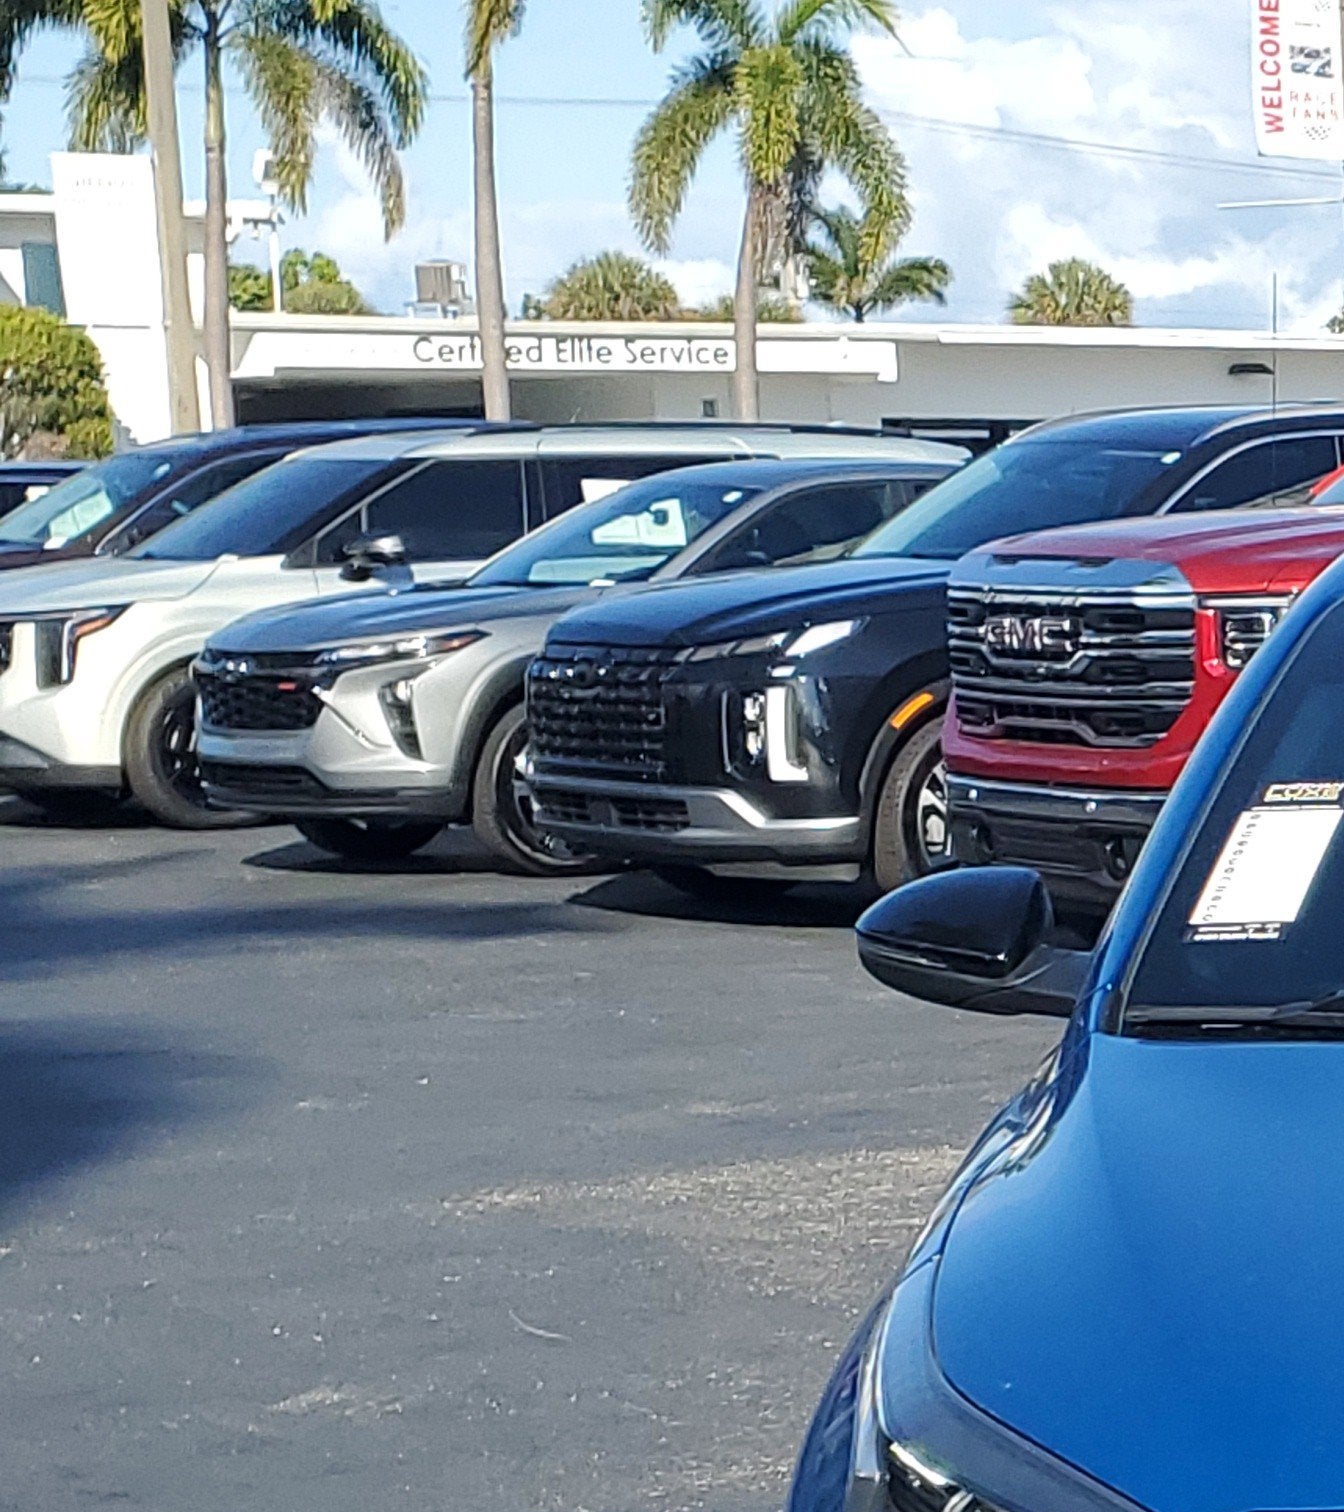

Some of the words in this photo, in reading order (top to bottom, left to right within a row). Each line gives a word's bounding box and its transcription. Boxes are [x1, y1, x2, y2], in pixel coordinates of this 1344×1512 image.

[1259, 0, 1284, 133] WELCOME
[1290, 91, 1336, 105] RAE
[412, 336, 542, 363] Certed
[555, 337, 612, 364] Elite
[624, 337, 729, 365] Service
[986, 616, 1075, 652] GMC
